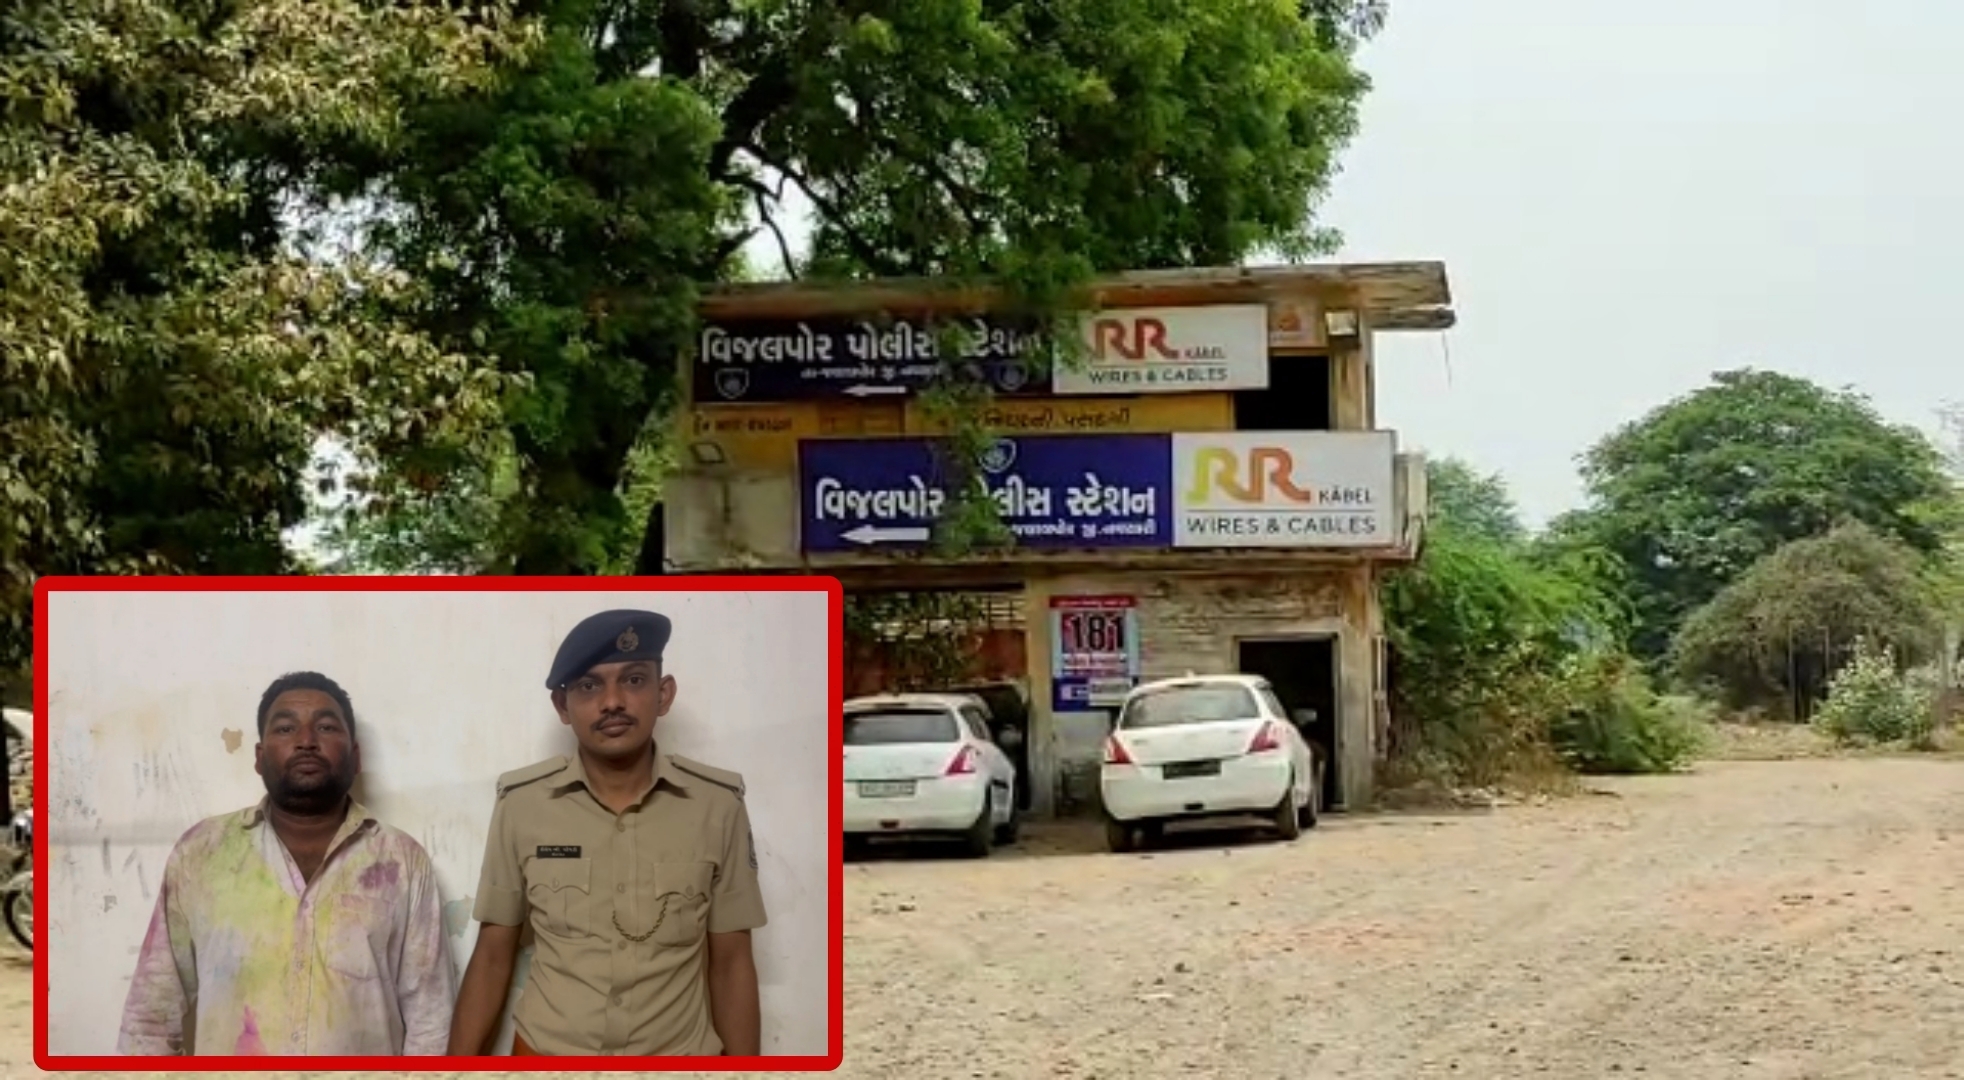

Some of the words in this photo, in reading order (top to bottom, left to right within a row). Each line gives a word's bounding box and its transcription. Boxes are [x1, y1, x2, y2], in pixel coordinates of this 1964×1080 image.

[701, 321, 834, 363] વિજલપોર
[1088, 369, 1142, 385] WIRES
[1146, 370, 1158, 382] &
[1162, 367, 1228, 382] CABLES
[1184, 446, 1311, 505] RR
[815, 474, 946, 520] વિજલપોર
[1065, 472, 1156, 517] સ્ટેશન
[1186, 516, 1259, 535] WIRES
[1266, 517, 1281, 535] &
[1287, 515, 1376, 535] CABLES
[1070, 615, 1125, 650] 181
